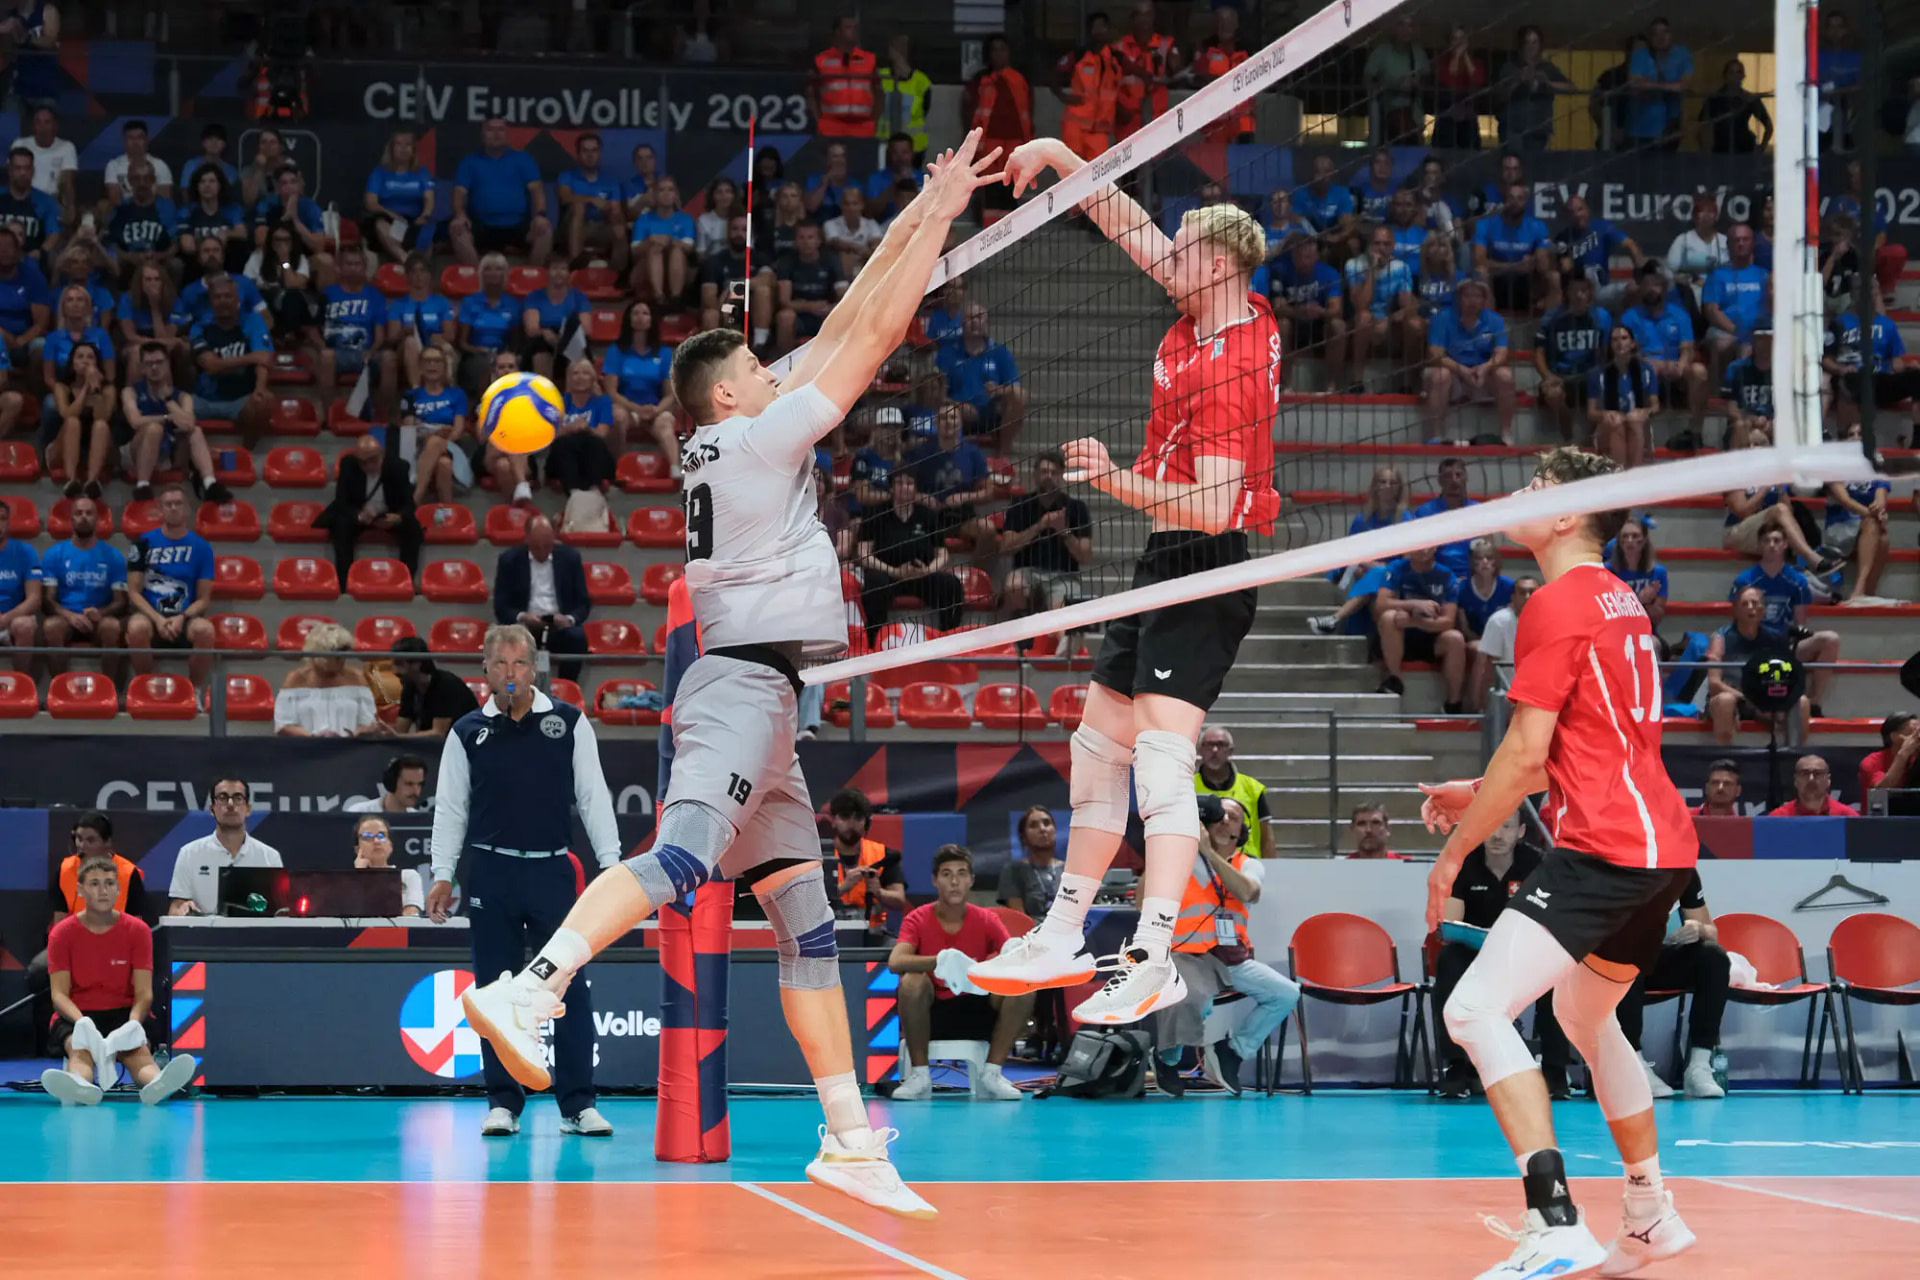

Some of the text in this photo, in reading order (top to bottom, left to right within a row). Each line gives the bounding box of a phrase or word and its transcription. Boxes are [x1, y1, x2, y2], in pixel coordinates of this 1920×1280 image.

[363, 81, 809, 132] CEV EuroVolley 2023
[1533, 181, 1589, 220] EV
[1624, 633, 1662, 723] 17
[727, 771, 753, 807] 19
[404, 837, 433, 856] CE
